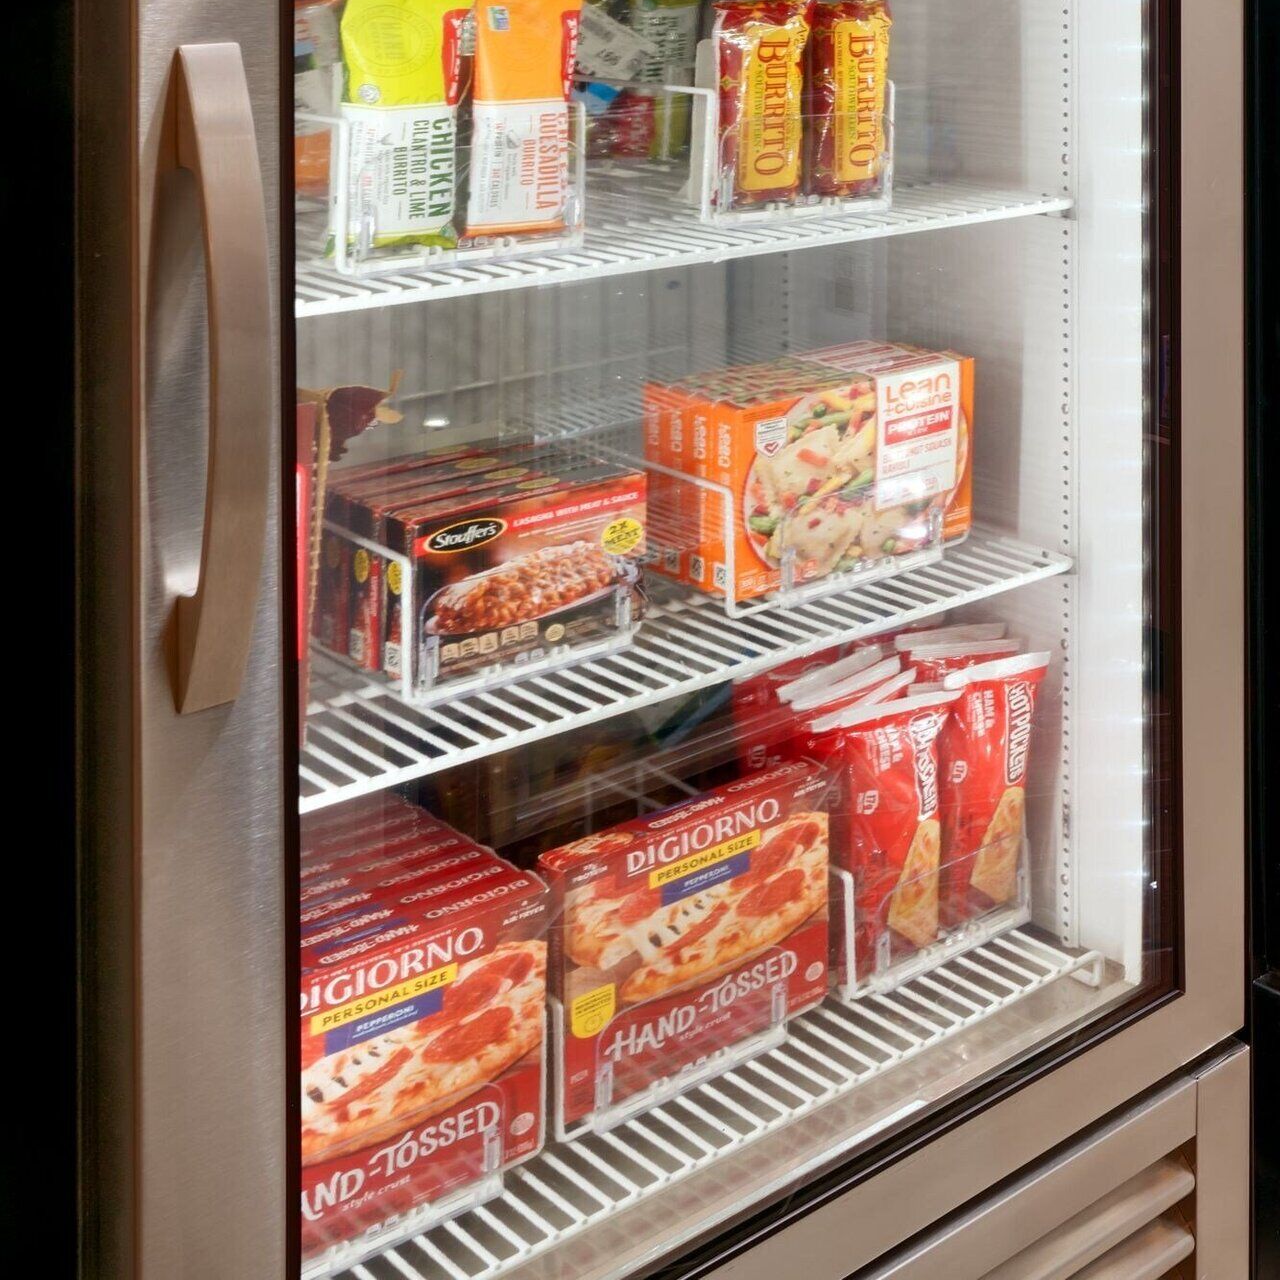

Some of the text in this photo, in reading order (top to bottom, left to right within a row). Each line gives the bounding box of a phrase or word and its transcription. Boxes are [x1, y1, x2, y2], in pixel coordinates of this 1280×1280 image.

[754, 36, 791, 176] BURRITO
[848, 32, 877, 168] BURRITO
[393, 147, 408, 196] BURRITO
[409, 120, 430, 177] CILANTRO
[428, 117, 451, 219] CHICKEN
[520, 139, 536, 187] BURRITO
[535, 112, 560, 211] QUESADILLA
[408, 188, 425, 220] LIME
[886, 372, 951, 404] Lean
[434, 522, 498, 550] Stouffer's
[657, 836, 754, 882] PERSONAL SIZE
[684, 863, 730, 887] PEPPERONI
[322, 970, 448, 1027] PERSONAL SIZE
[356, 1004, 414, 1032] PEPPERONI
[604, 950, 799, 1063] HAND-TOSSED
